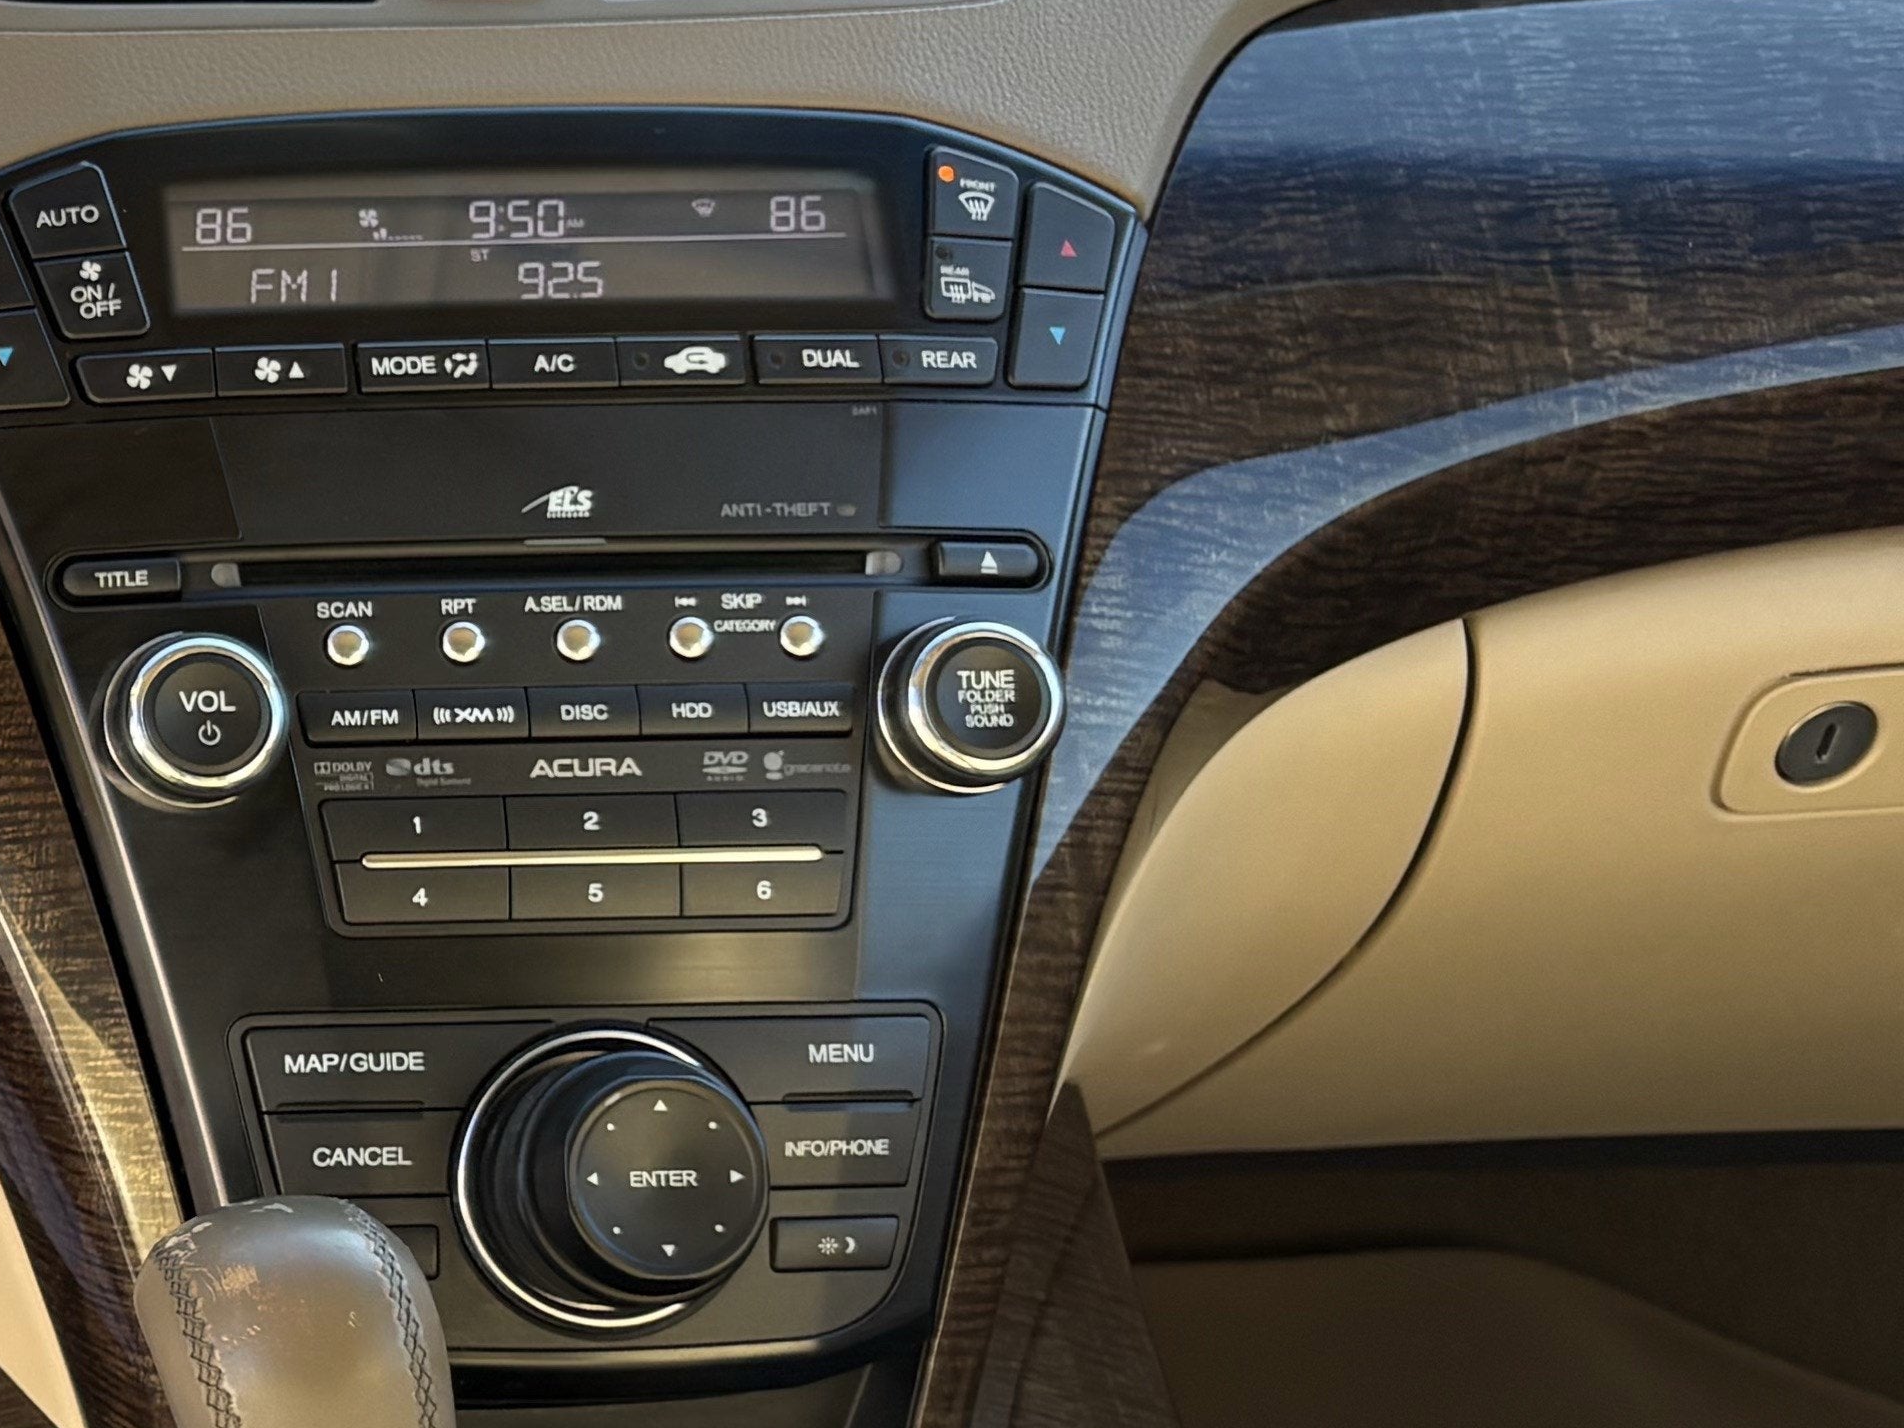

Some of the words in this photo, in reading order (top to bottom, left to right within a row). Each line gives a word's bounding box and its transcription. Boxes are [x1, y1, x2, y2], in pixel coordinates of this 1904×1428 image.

[36, 205, 99, 229] AUTO
[469, 199, 565, 239] 9:50
[770, 195, 826, 232] 86
[195, 207, 252, 245] 86
[79, 300, 121, 320] OFF
[372, 356, 436, 375] MODE
[534, 353, 576, 373] A/C
[802, 349, 859, 369] DUAL
[921, 350, 977, 369] REAR
[95, 570, 148, 589] TITLE
[316, 601, 373, 619] SCAN
[441, 598, 475, 615] RPT
[721, 593, 763, 609] SKIP
[714, 619, 777, 633] CATEGORY
[956, 669, 1015, 690] TUNE
[179, 690, 236, 713] VOL
[957, 690, 1015, 703] FOLDER
[331, 709, 399, 726] AM/FM
[561, 704, 608, 720] DISC
[672, 703, 712, 718] HDD
[762, 701, 839, 718] USB/AUX
[971, 704, 1004, 714] PUSH
[965, 714, 1014, 728] SOUND
[332, 761, 372, 772] DOLBY
[414, 758, 454, 775] dts
[530, 758, 642, 777] ACURA
[703, 751, 749, 765] DVD
[413, 816, 421, 834] 1
[583, 811, 600, 830] 2
[752, 808, 768, 827] 3
[412, 888, 428, 906] 4
[588, 883, 604, 902] 5
[757, 881, 772, 899] 6
[284, 1051, 425, 1074] MAP/GUIDE
[808, 1043, 875, 1064] MENU
[312, 1146, 413, 1167] CANCEL
[784, 1139, 890, 1158] INFO/PHONE
[629, 1170, 697, 1188] ENTER
